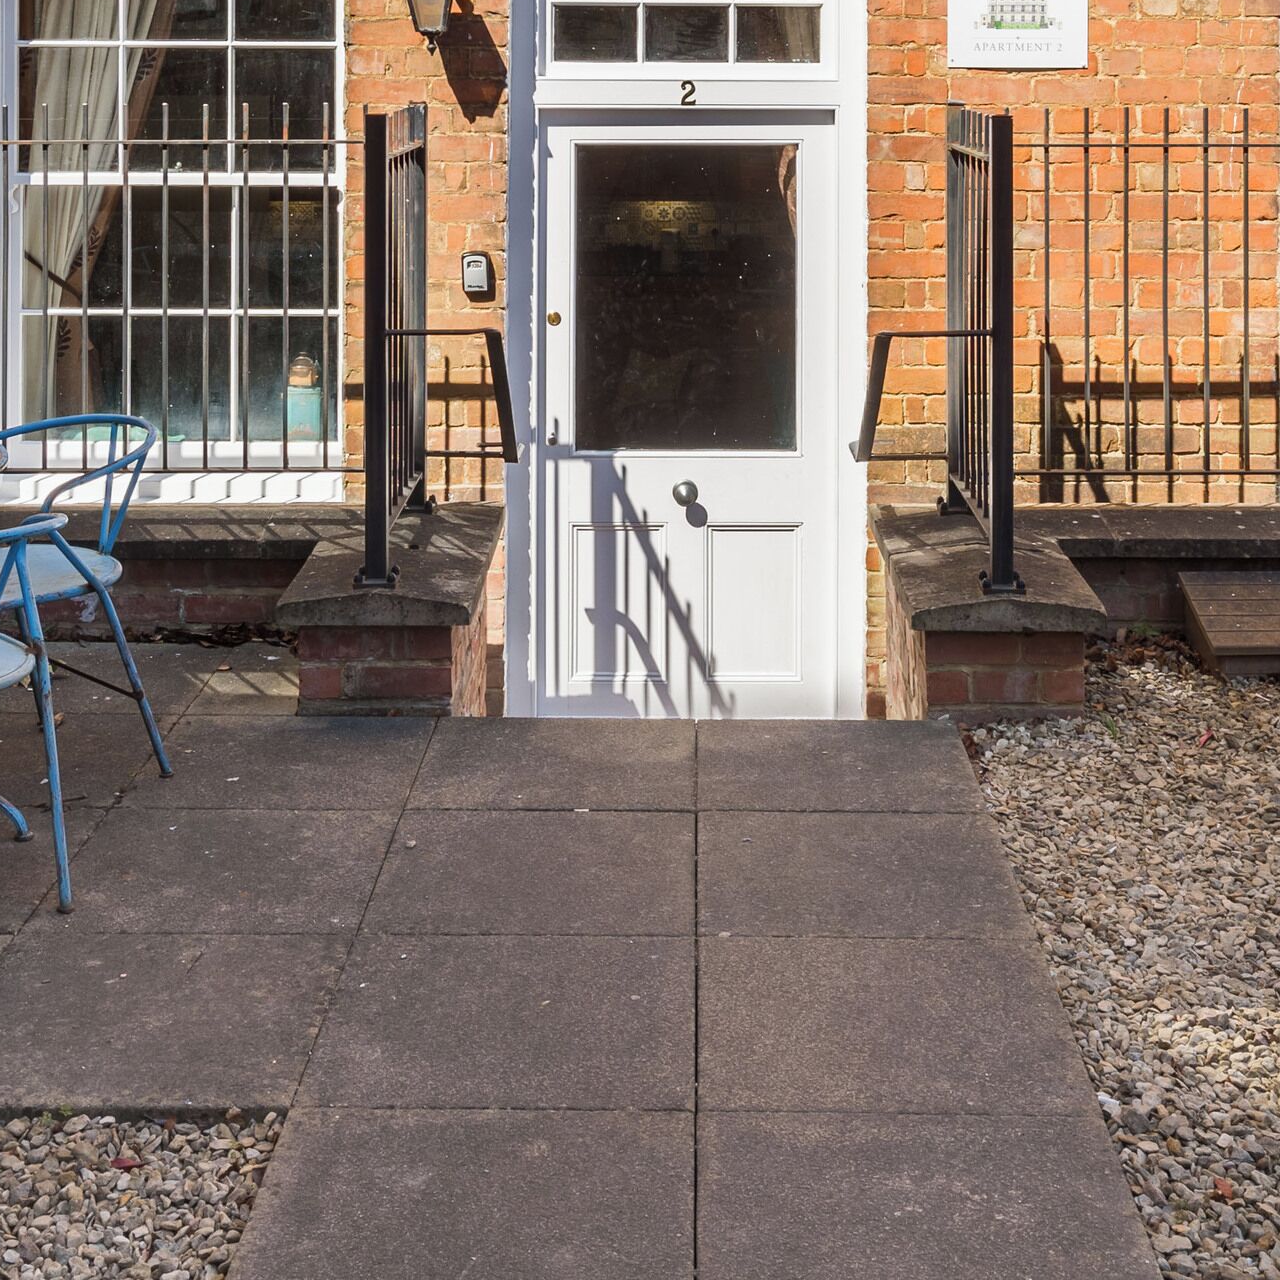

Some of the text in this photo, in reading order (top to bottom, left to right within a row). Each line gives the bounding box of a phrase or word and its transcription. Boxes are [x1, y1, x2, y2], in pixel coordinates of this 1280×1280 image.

[973, 42, 1063, 52] APARTMENT 2
[681, 80, 696, 105] 2
